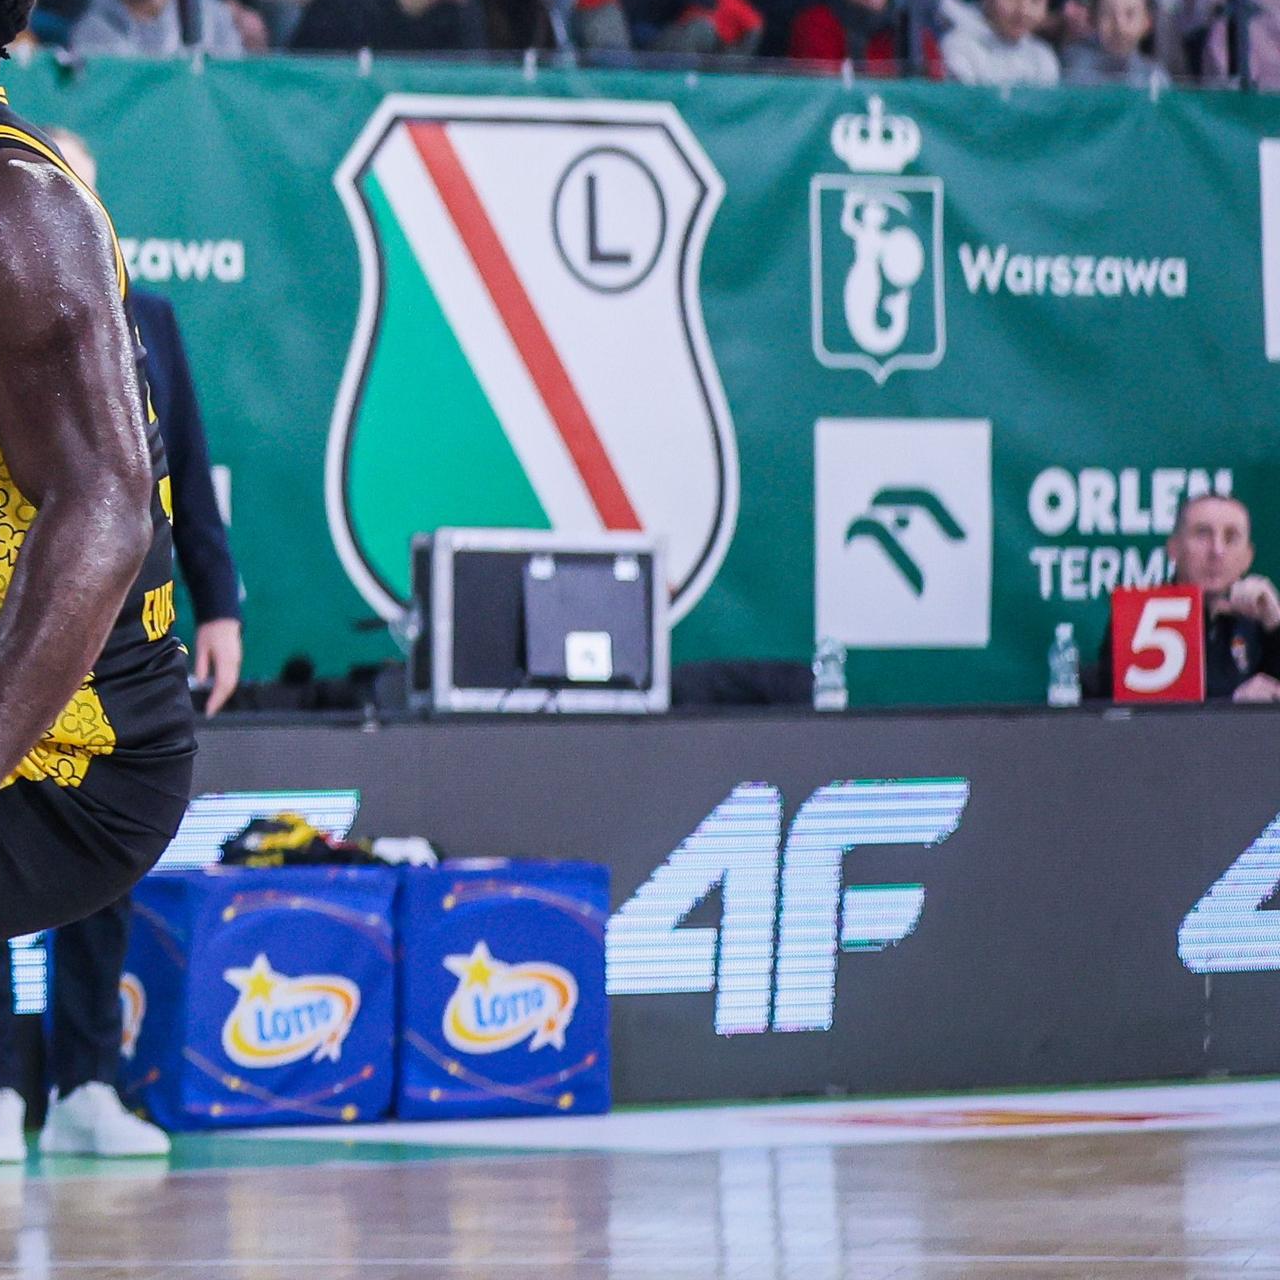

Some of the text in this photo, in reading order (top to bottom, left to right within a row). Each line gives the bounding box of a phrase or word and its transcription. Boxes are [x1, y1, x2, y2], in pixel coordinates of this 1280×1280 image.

[117, 236, 246, 284] zawa
[958, 242, 1190, 301] Warszawa
[1028, 546, 1176, 602] TERM
[1124, 596, 1192, 694] 5
[605, 776, 971, 1036] 4F
[254, 997, 337, 1045] LOTTO
[473, 985, 547, 1029] LOTTO
